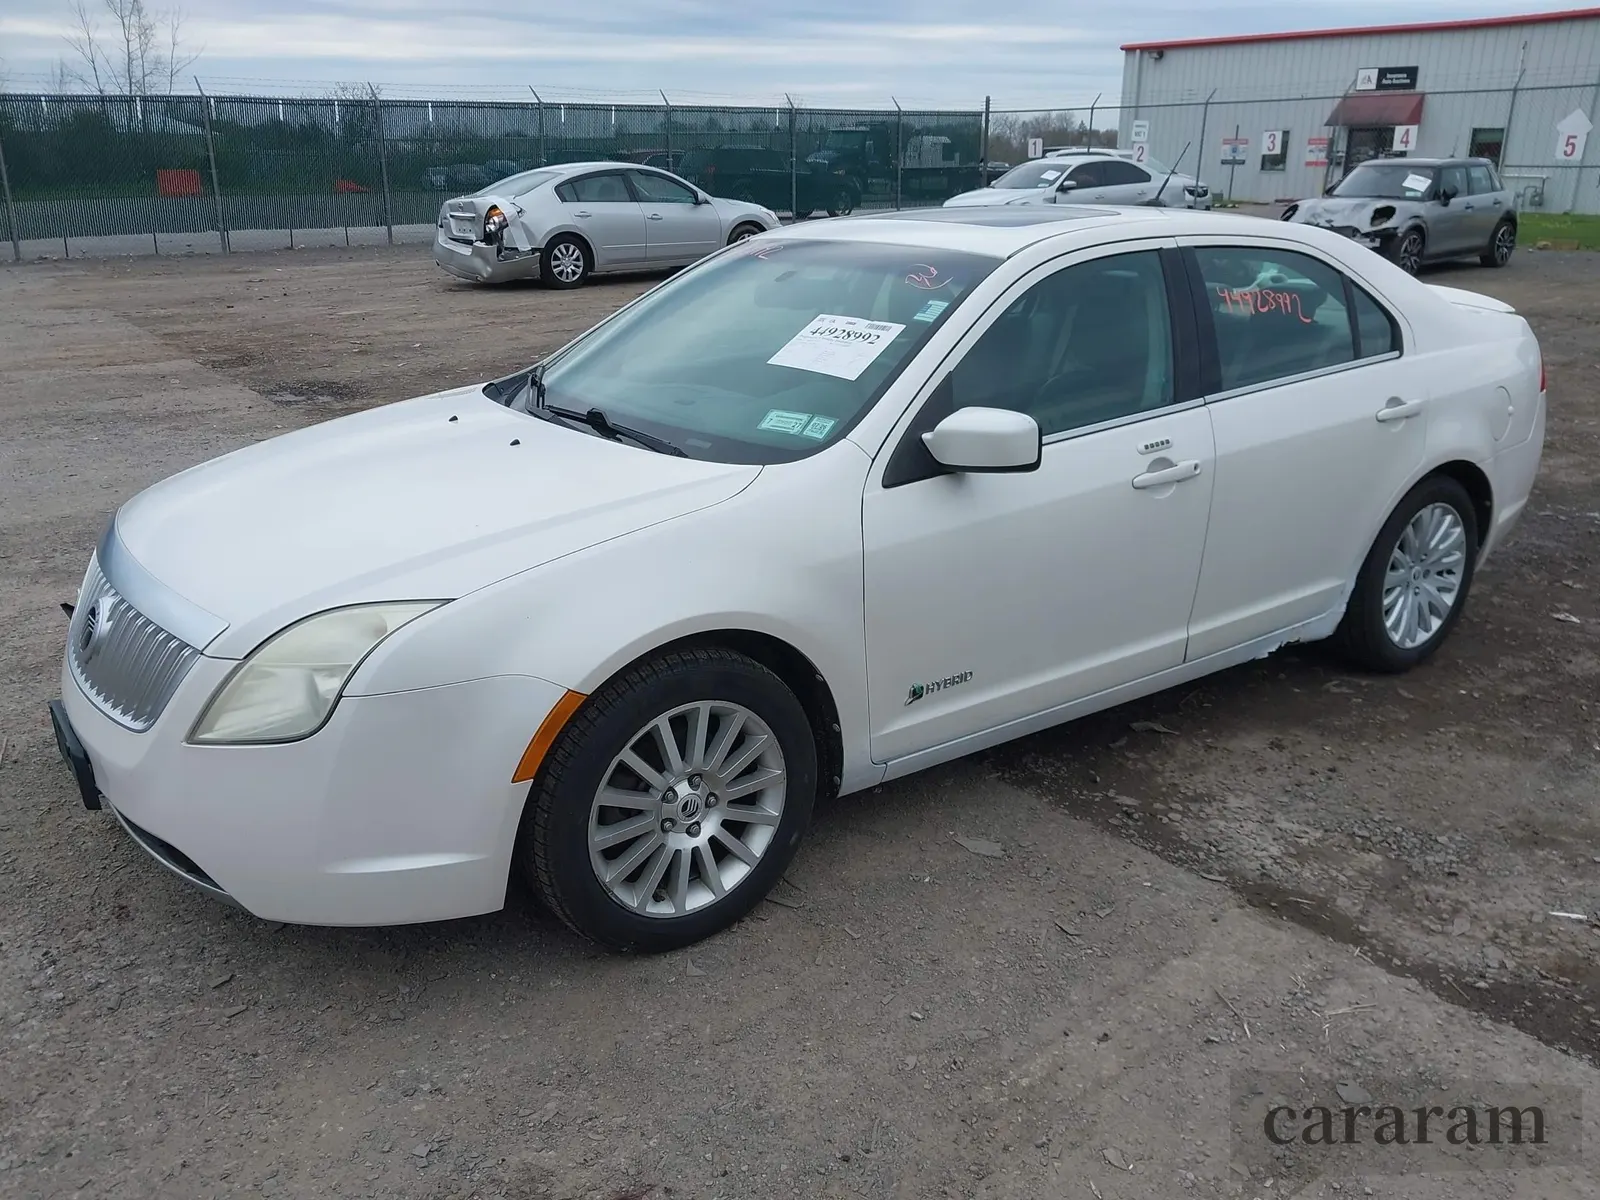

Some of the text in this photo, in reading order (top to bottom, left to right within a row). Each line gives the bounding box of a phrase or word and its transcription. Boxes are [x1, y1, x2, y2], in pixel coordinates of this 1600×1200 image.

[1031, 139, 1037, 157] 1
[1267, 133, 1276, 152] 3
[1399, 128, 1410, 149] 4
[1563, 134, 1578, 157] 5
[1136, 145, 1145, 163] 2
[810, 326, 881, 345] 44928992
[925, 669, 974, 695] HYBRID
